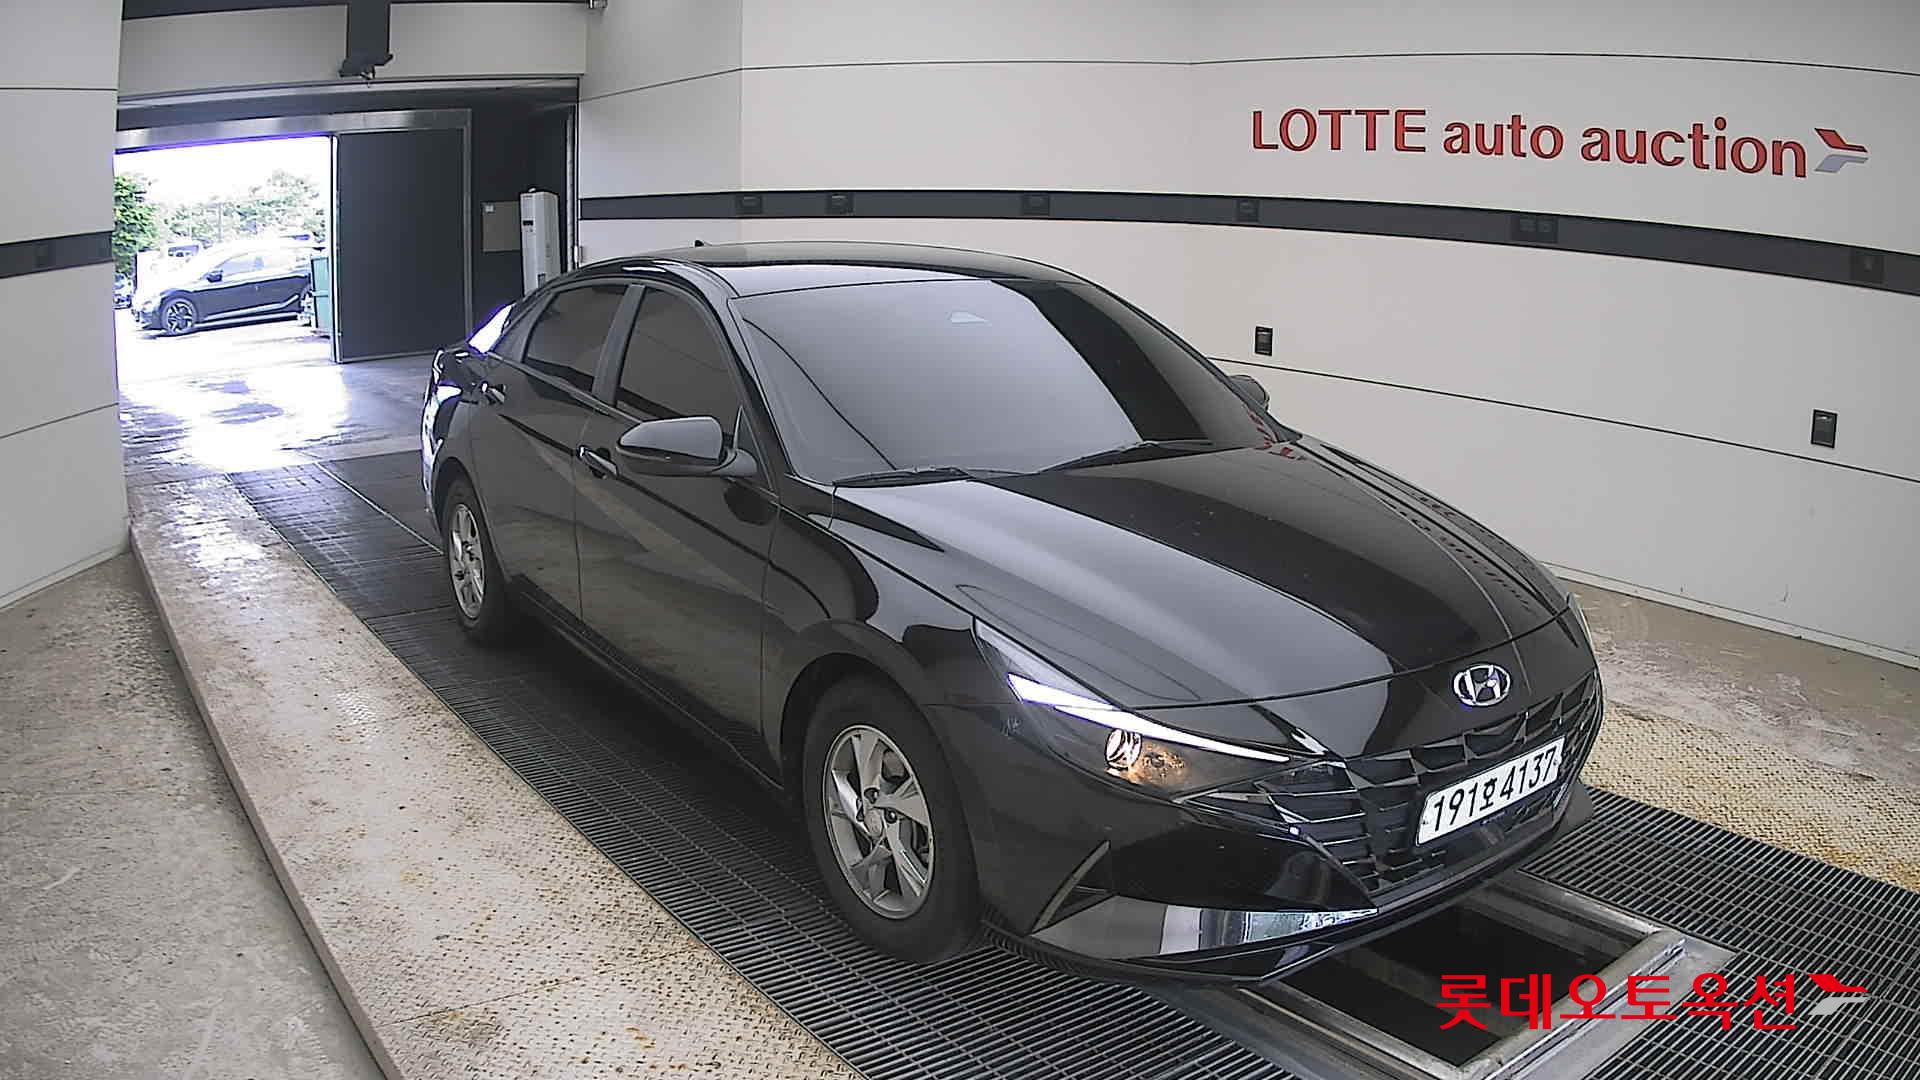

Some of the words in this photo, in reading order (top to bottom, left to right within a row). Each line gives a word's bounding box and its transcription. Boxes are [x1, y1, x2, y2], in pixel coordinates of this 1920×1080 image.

[1252, 108, 1426, 152] LOTTE
[1443, 114, 1563, 159] auto
[1581, 117, 1807, 178] auction
